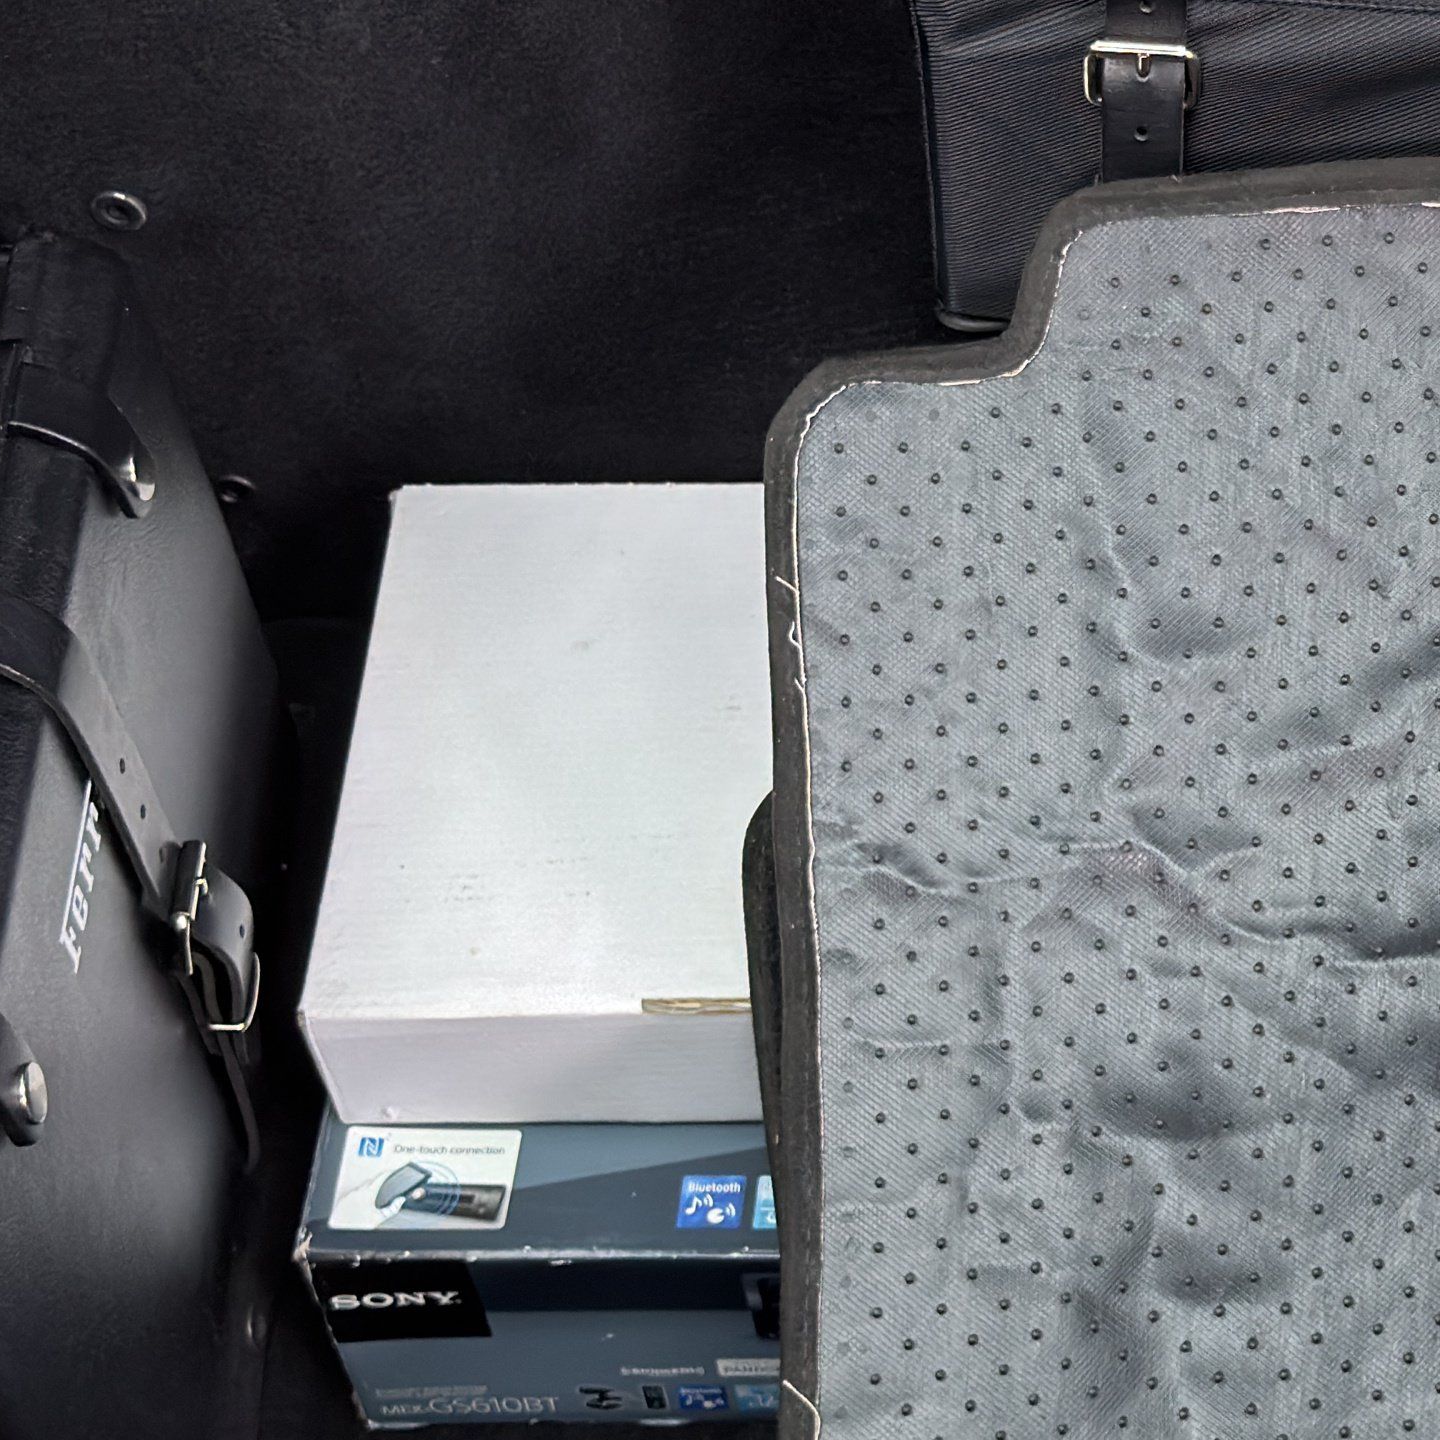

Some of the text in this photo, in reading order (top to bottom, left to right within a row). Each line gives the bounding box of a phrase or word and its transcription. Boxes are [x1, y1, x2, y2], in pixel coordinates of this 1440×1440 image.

[59, 776, 104, 975] Ferr
[394, 1143, 506, 1156] One-touch connection
[687, 1180, 741, 1193] Bluetooth
[330, 1291, 461, 1311] SONY
